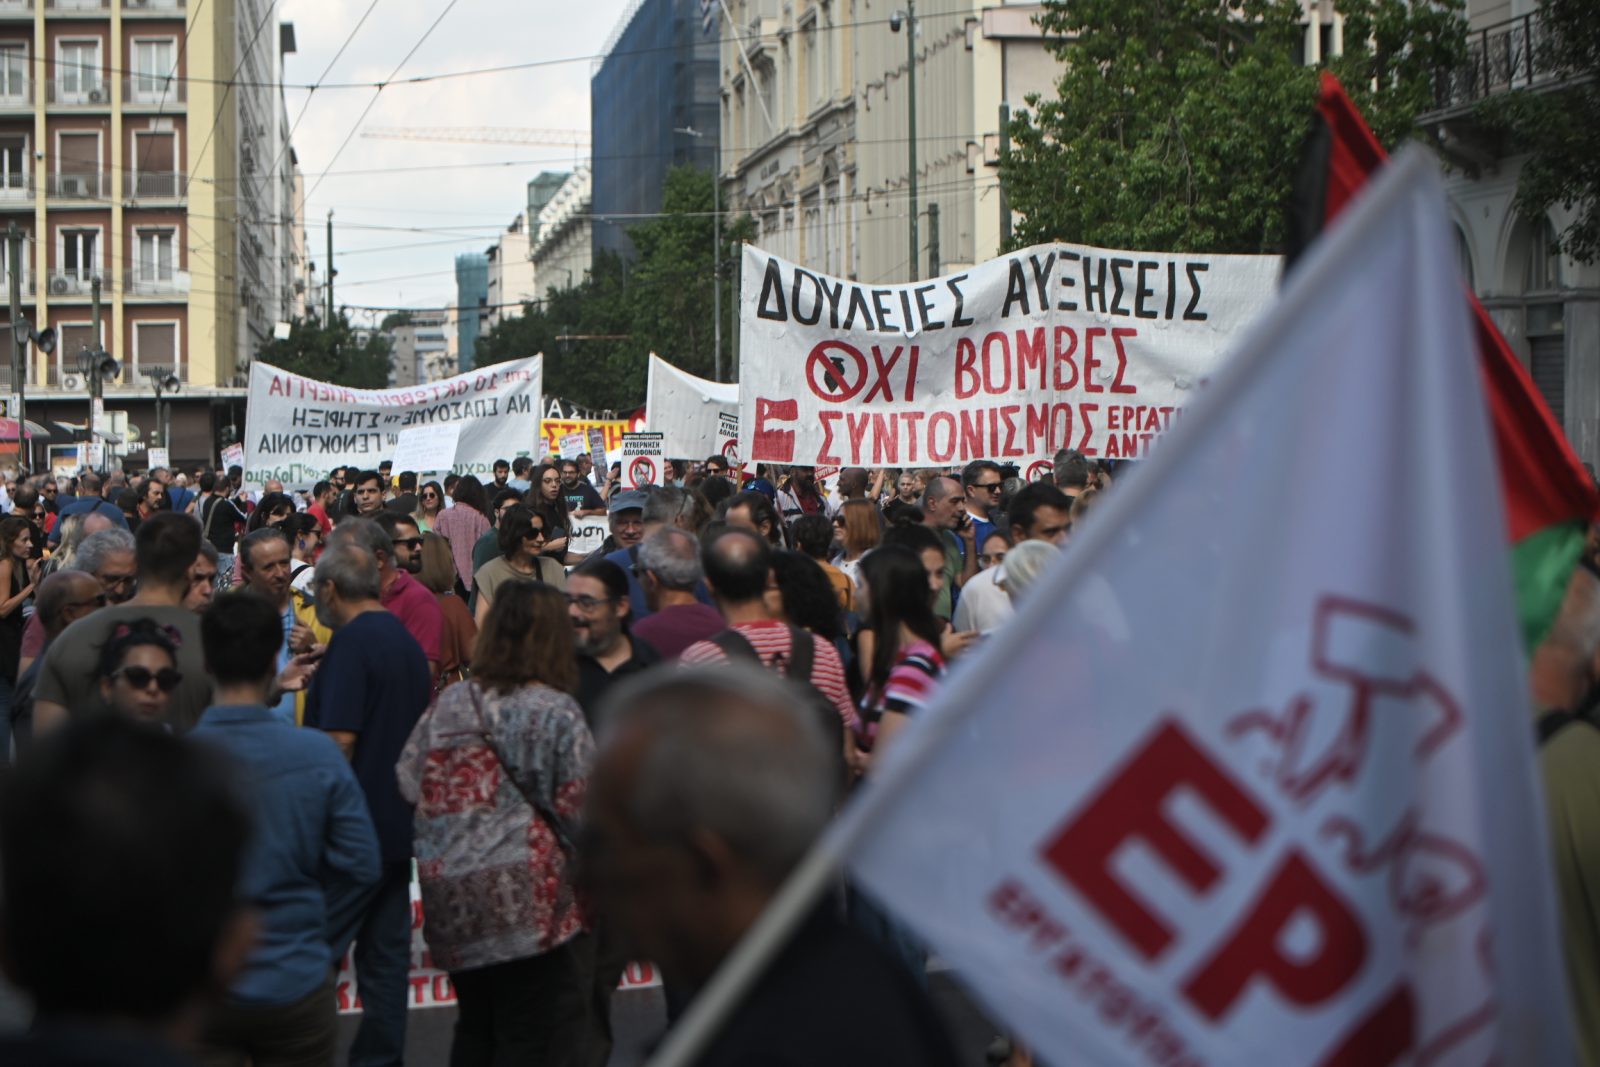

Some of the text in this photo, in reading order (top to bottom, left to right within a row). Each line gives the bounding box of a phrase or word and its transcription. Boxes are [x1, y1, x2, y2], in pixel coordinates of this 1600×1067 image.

[757, 251, 1209, 332] ΔΟΥΛΕΙΕΣ ΑΥΞΗΣΕΙΣ
[805, 326, 1138, 403] ΟΧΙ ΒΟΜΒΕΣ
[1107, 405, 1182, 432] ΕΡΓΑΤ
[625, 441, 660, 449] ΚΥΒΕΡΝΗΣΗ
[816, 403, 1099, 465] ΣΥΝΤΟΝΙΣΜΟΣ
[1105, 433, 1162, 458] ΑΝΤ
[570, 526, 604, 541] ωση
